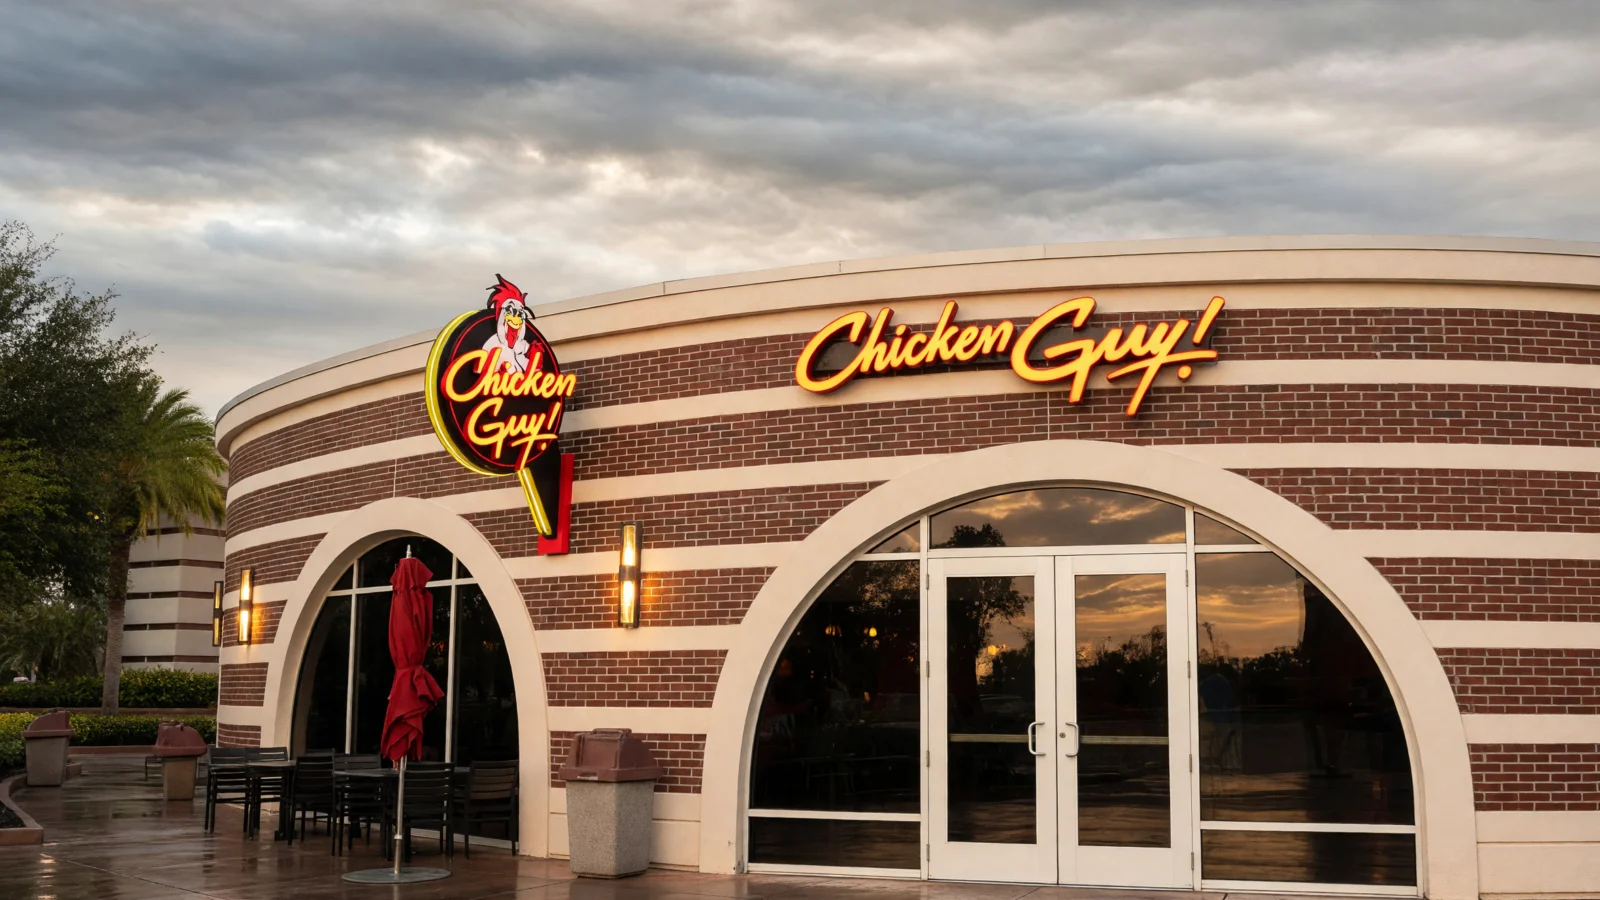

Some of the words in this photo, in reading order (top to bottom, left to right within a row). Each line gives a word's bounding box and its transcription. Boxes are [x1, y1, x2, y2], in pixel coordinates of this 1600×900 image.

[442, 347, 576, 402] Chicken
[795, 300, 1015, 394] Chicken
[1010, 295, 1225, 417] Guy!
[465, 397, 561, 471] Guy!
